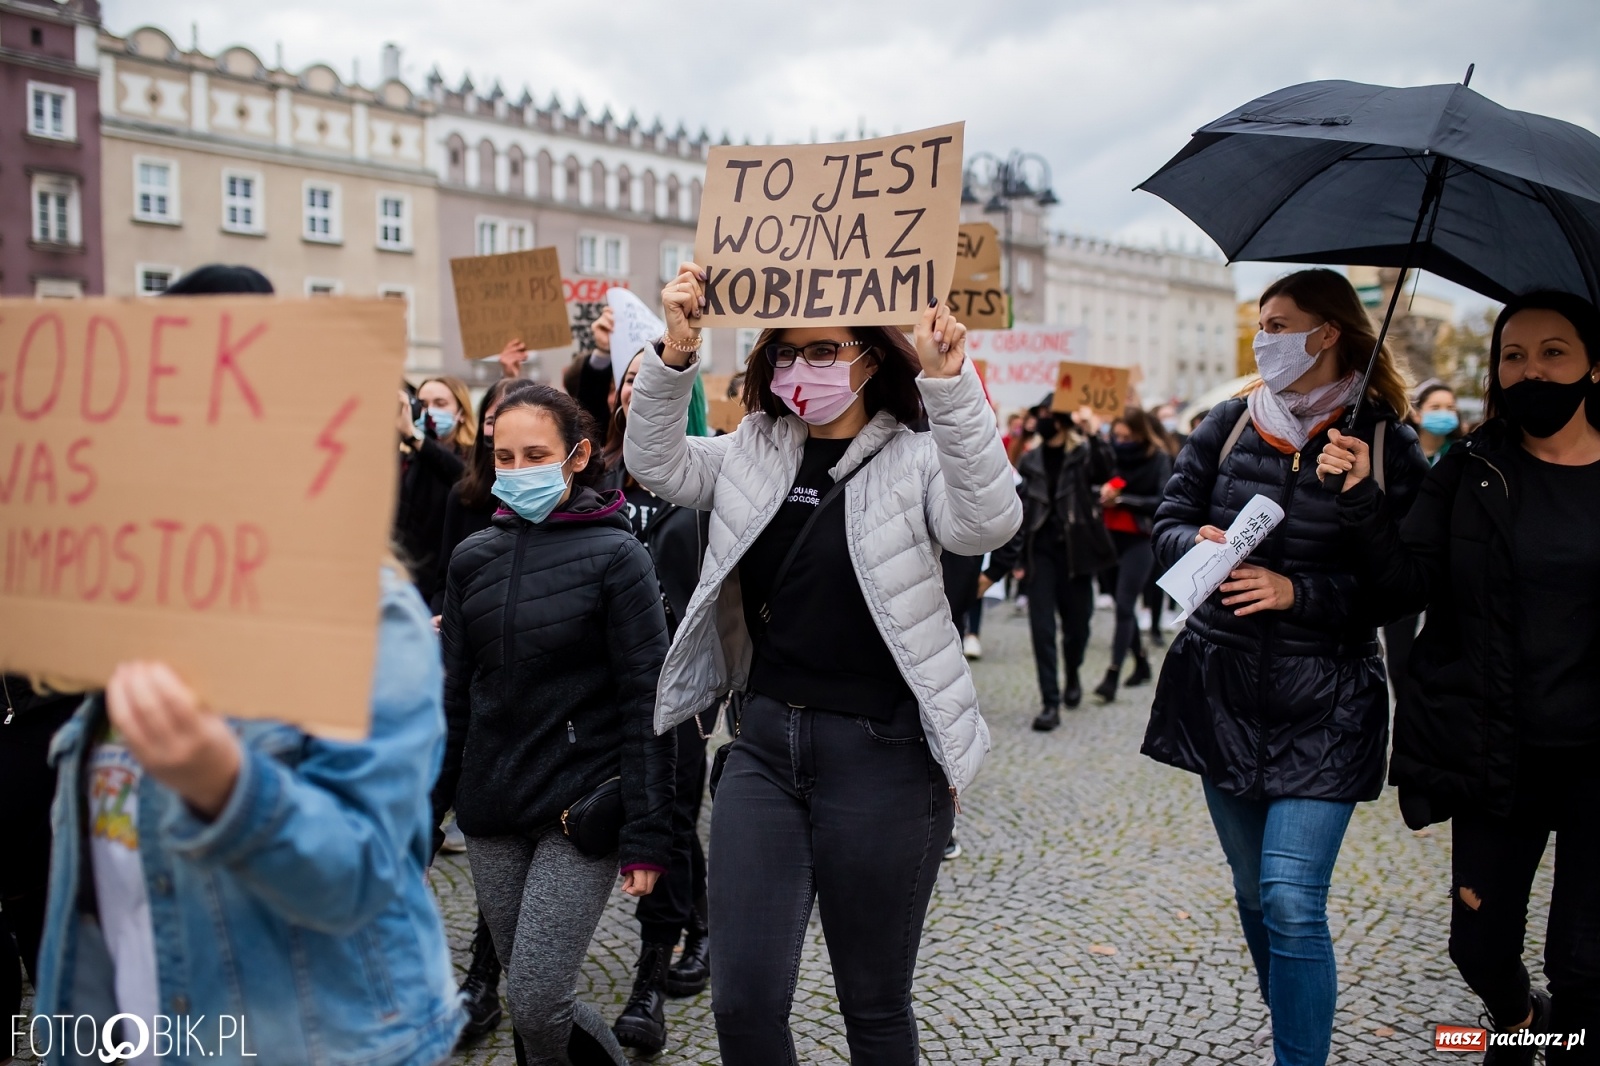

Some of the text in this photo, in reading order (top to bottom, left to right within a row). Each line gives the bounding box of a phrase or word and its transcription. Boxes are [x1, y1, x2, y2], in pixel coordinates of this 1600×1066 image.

[725, 135, 953, 213] TO JEST
[713, 207, 927, 261] WOJNA Z
[529, 274, 559, 302] PIS
[1079, 385, 1118, 411] SUS
[799, 495, 820, 505] CLOSE
[804, 488, 819, 497] ARE
[1246, 516, 1264, 535] TAK
[2, 519, 270, 613] IMPOSTOR
